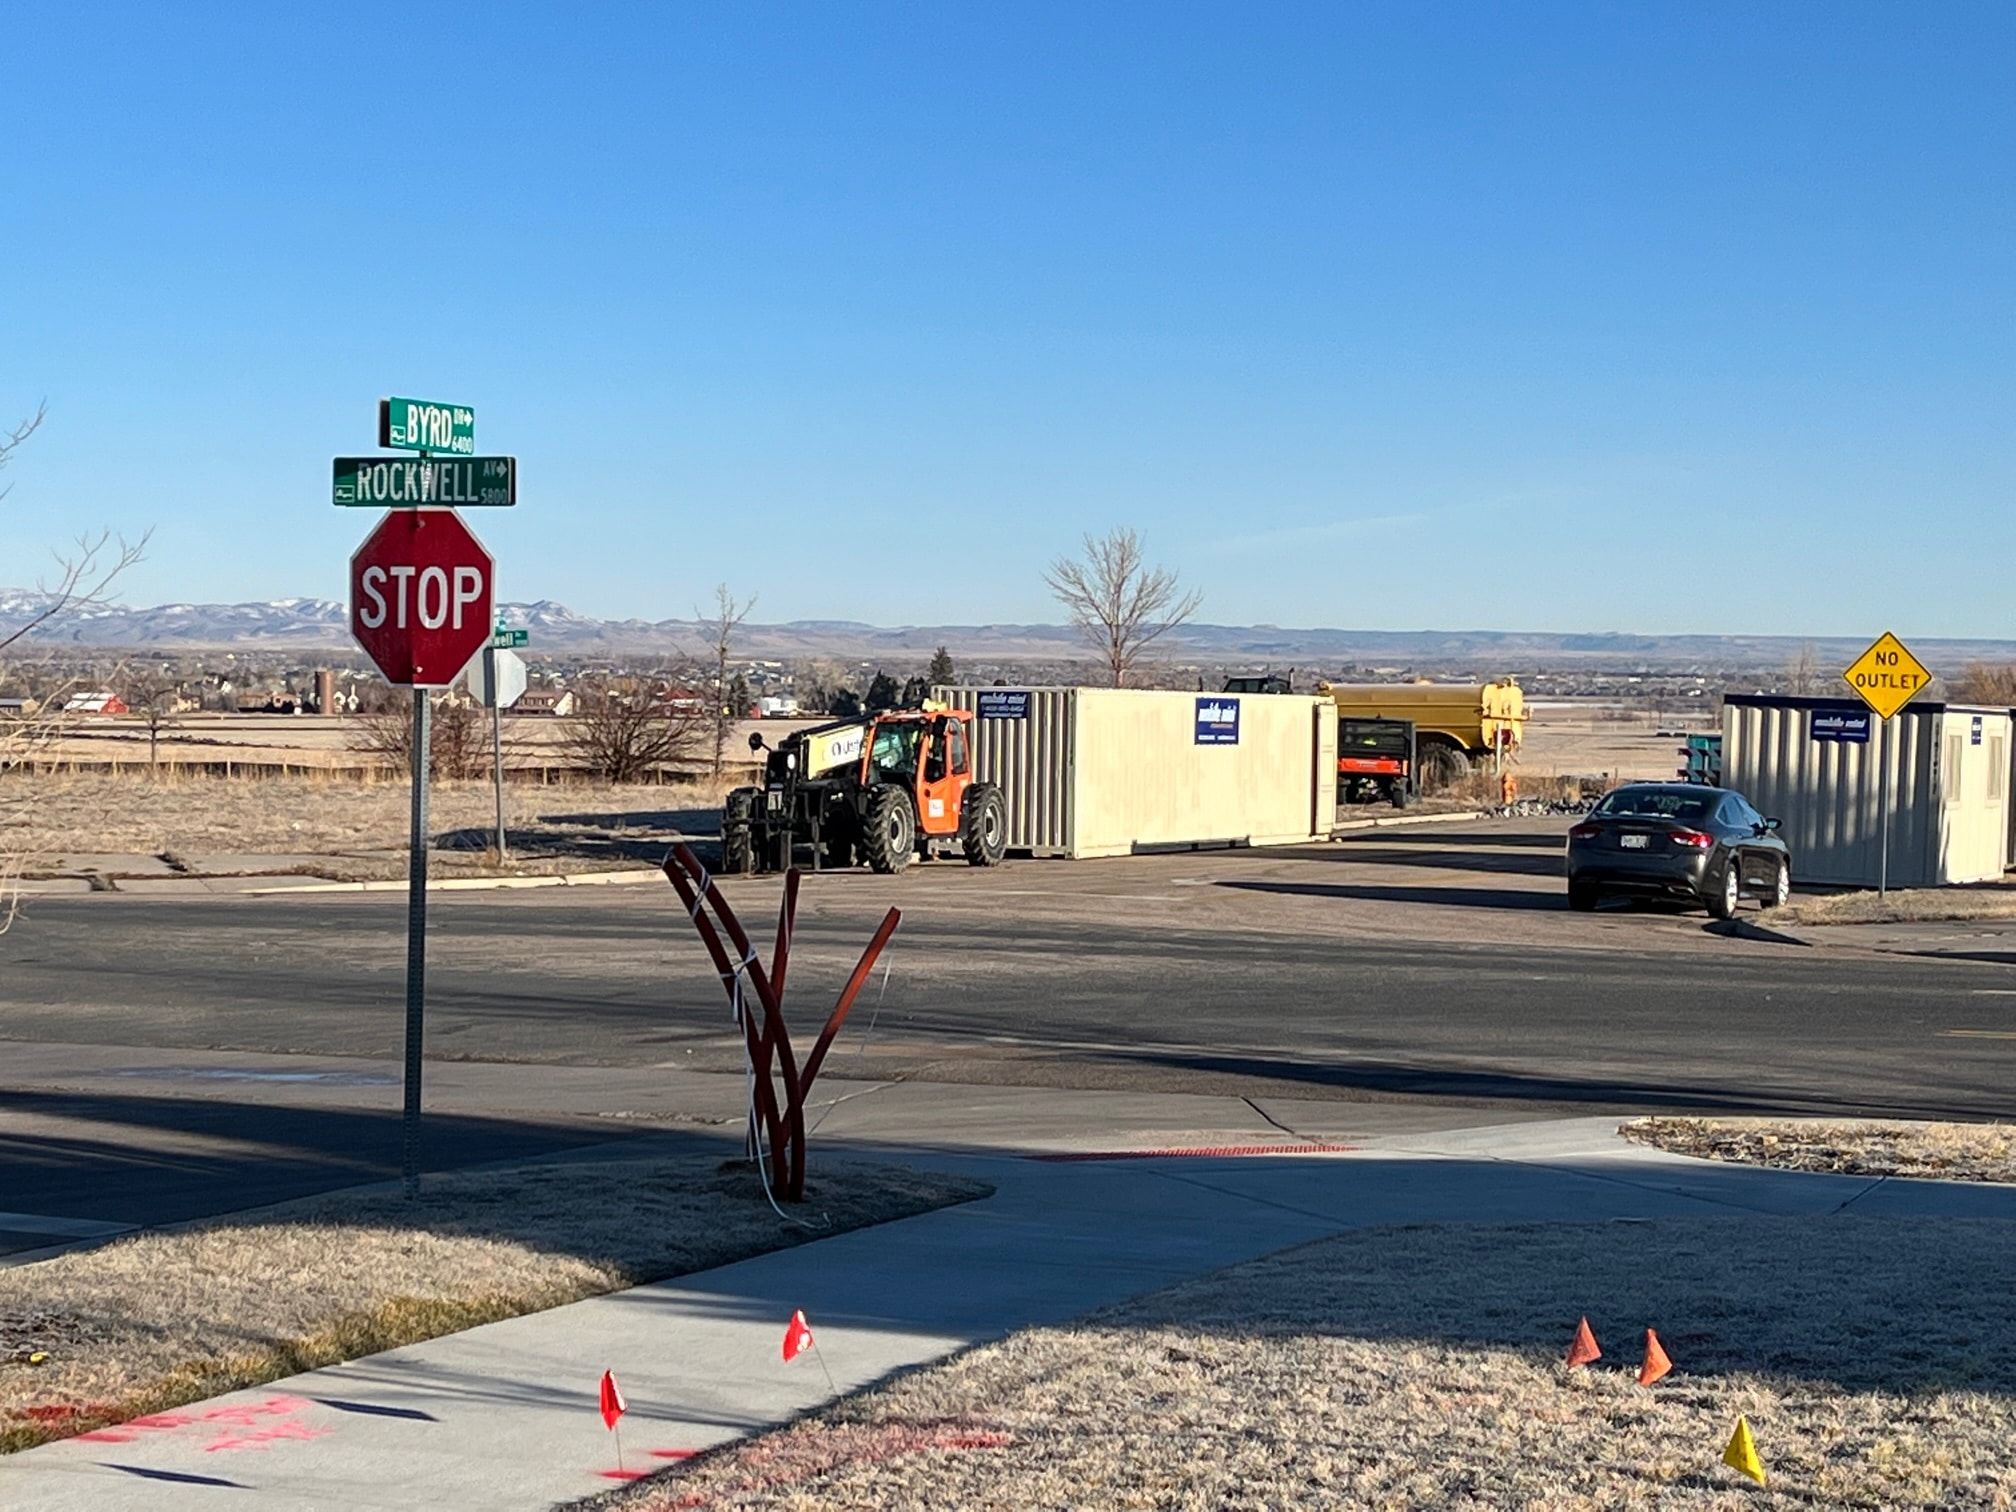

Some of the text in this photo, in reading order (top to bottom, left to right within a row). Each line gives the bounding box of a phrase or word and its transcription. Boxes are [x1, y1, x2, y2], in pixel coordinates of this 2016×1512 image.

[407, 404, 452, 448] BYRD
[357, 462, 479, 502] ROCKWELL
[360, 566, 483, 630] STOP
[1875, 651, 1899, 666] NO
[1855, 673, 1920, 689] OUTLET
